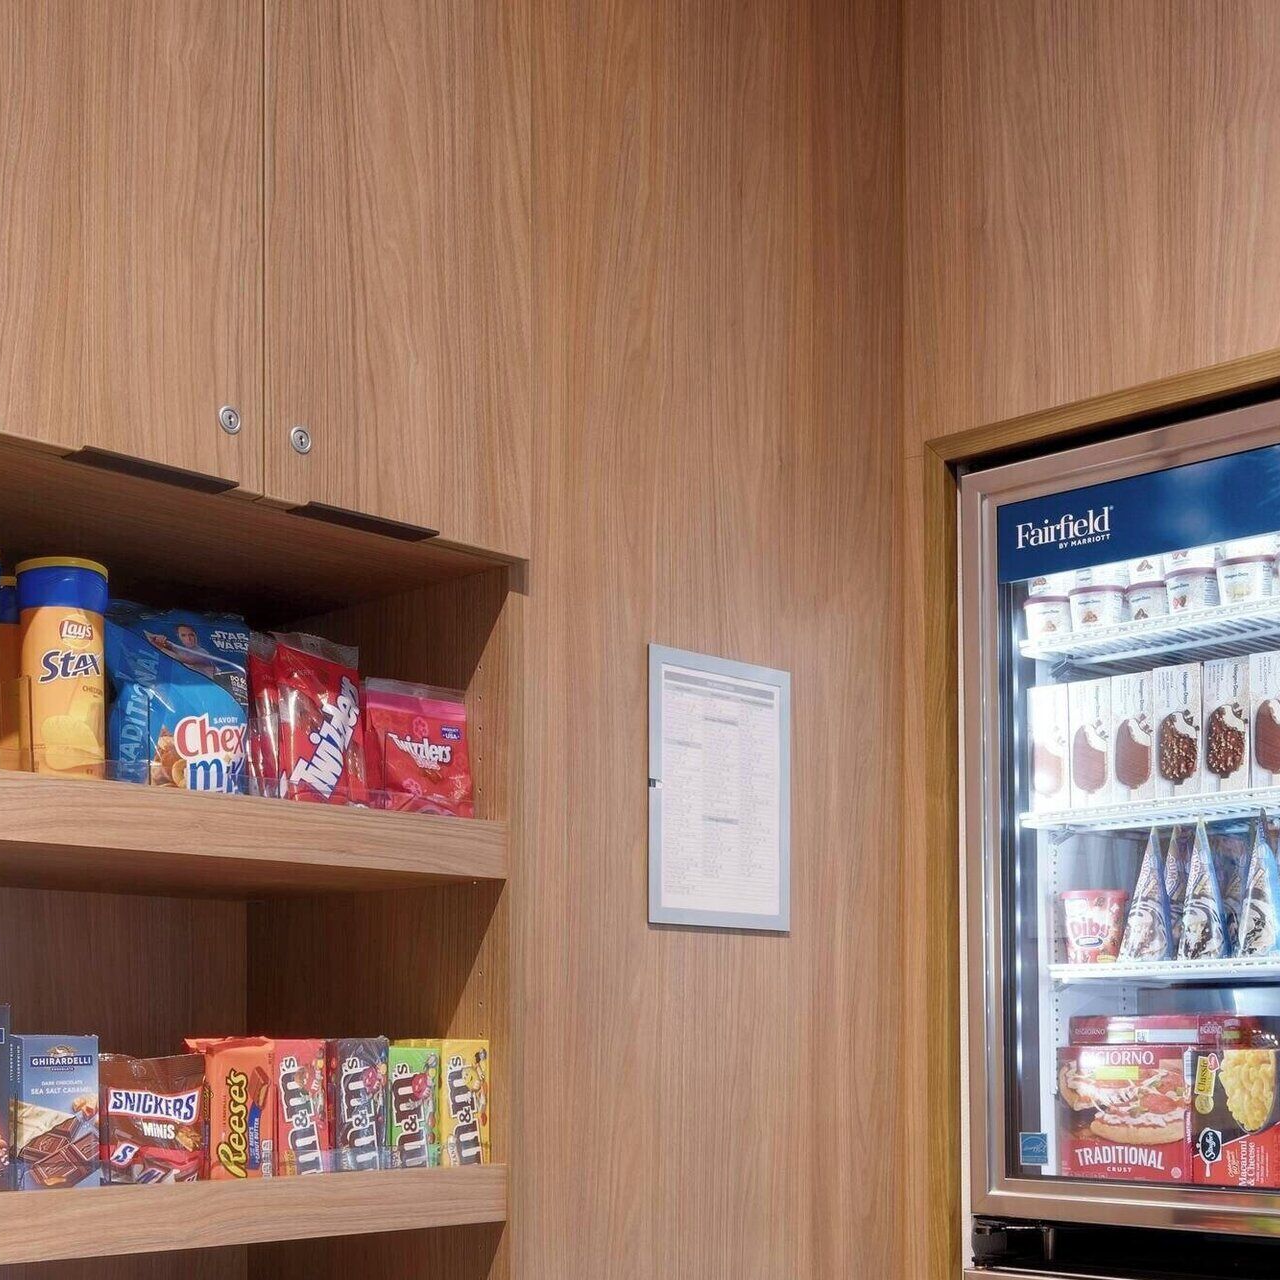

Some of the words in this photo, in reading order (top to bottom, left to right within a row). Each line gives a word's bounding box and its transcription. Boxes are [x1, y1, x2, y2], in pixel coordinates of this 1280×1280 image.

[1015, 506, 1111, 550] Fairfield
[1070, 533, 1111, 547] MARRIOTT
[176, 713, 247, 758] Chex
[32, 1057, 91, 1066] GHIRARDELLI
[112, 1091, 196, 1121] SNICKERS
[218, 1068, 248, 1178] Reese's
[1074, 1142, 1165, 1170] TRADITIONAL
[1107, 1165, 1132, 1173] CRUST
[1239, 1140, 1247, 1186] Macaroni
